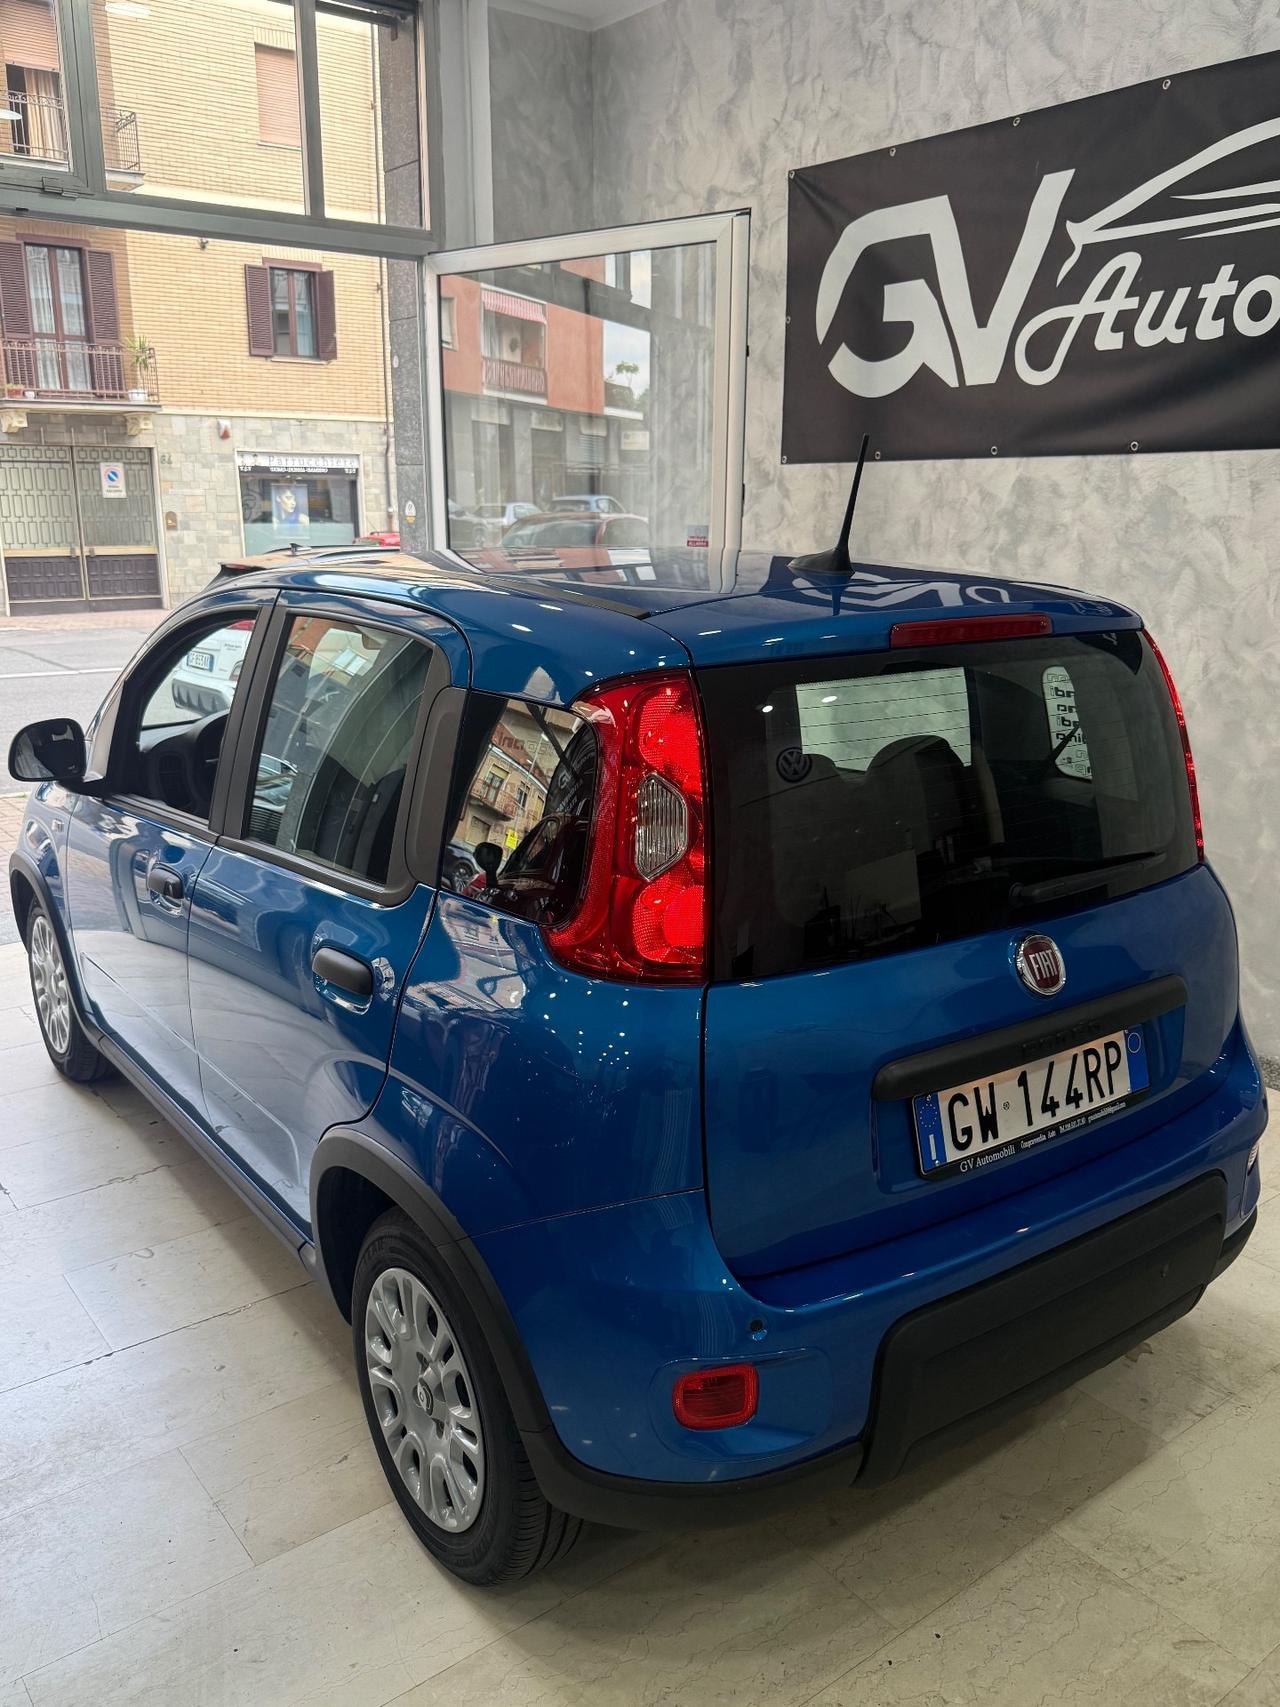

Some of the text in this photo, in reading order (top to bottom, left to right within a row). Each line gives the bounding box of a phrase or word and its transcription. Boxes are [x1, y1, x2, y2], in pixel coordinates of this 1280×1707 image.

[816, 169, 1075, 398] GV
[1014, 251, 1280, 386] Auto
[1029, 949, 1058, 981] FIAT
[948, 1040, 1122, 1152] GW 144RP
[960, 1158, 975, 1173] GV
[975, 1144, 1016, 1168] Automobili
